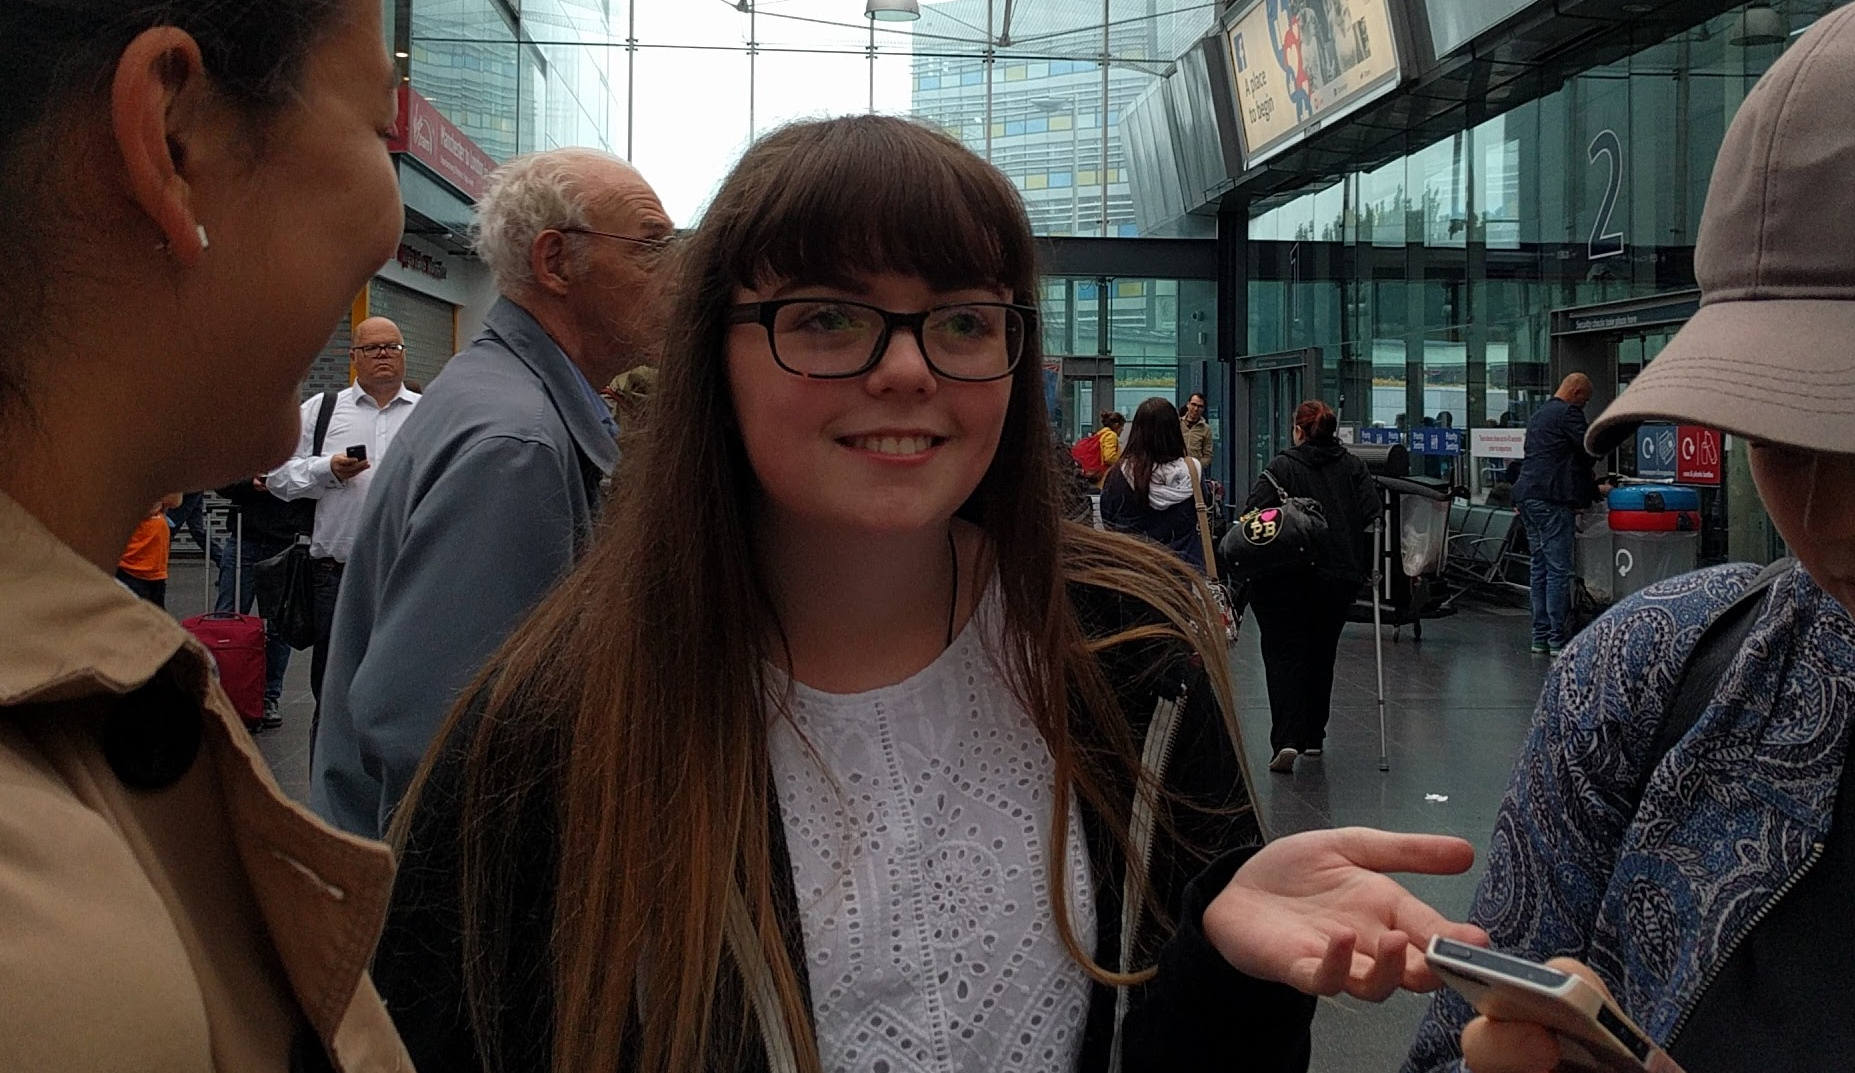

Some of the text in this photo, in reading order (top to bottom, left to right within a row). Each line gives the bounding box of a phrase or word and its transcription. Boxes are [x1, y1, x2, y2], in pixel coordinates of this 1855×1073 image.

[1244, 71, 1267, 99] A place
[1248, 93, 1275, 124] to begin
[1588, 129, 1624, 260] 2
